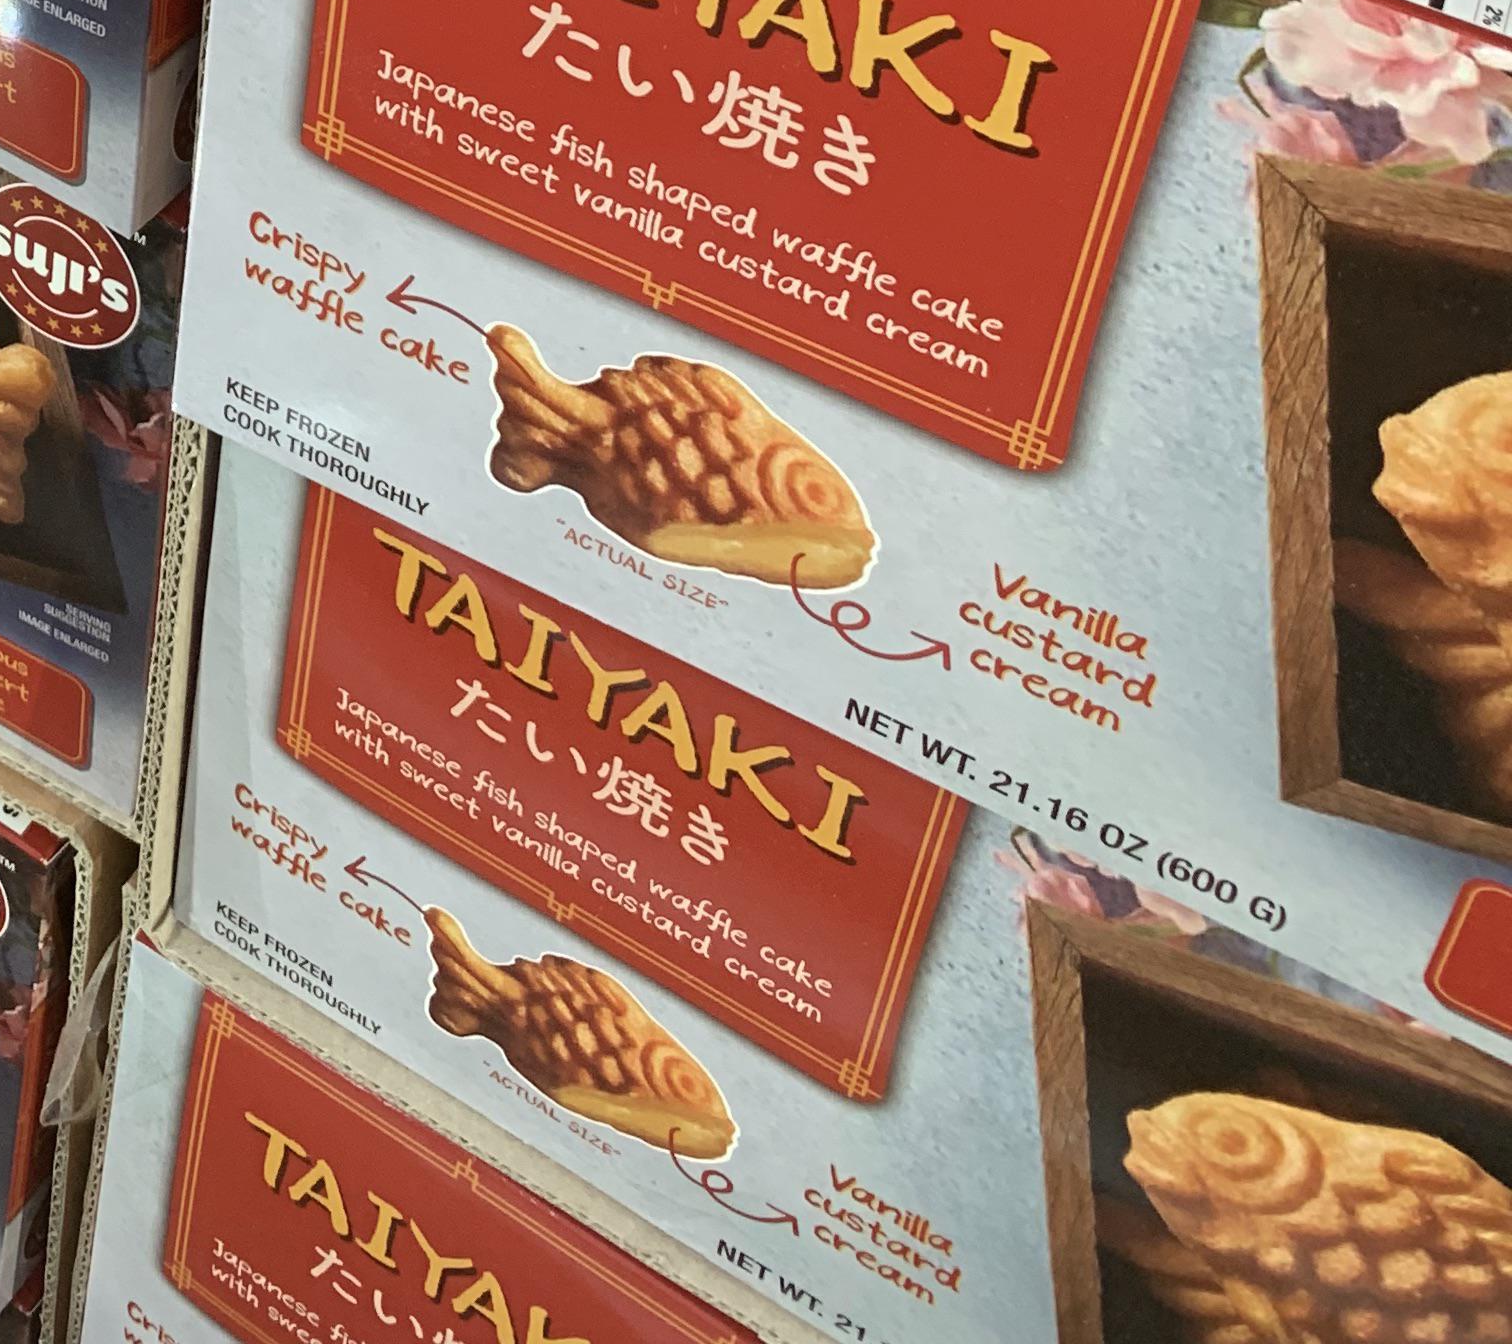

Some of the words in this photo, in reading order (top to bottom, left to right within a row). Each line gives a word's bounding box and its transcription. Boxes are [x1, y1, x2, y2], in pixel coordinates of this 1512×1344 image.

[43, 0, 106, 38] ENLARGED
[518, 1, 878, 198] たい焼き
[250, 211, 367, 297] Crispy
[374, 91, 444, 145] with
[457, 132, 559, 196] sweet
[573, 177, 685, 251] vanilla
[698, 238, 850, 323] custard
[865, 312, 990, 379] cream
[377, 49, 536, 143] Japanese
[550, 125, 614, 178] fish
[628, 162, 758, 244] shaped
[771, 221, 897, 298] waffle
[912, 285, 1005, 342] cake
[244, 253, 368, 330] waffle
[380, 322, 472, 387] cake
[222, 402, 280, 448] COOK
[284, 430, 431, 518] THOROUGHLY
[225, 376, 279, 421] KEEP
[284, 406, 371, 463] FROZEN
[958, 596, 1158, 710] custard
[992, 561, 1148, 661] Vanilla
[374, 527, 868, 864] TAIYAKI
[970, 644, 1123, 734] cream
[234, 782, 329, 861] Crispy
[447, 675, 729, 866] たい焼き
[845, 698, 914, 747] NET
[921, 732, 977, 781] WT.
[989, 769, 1089, 832] 21.16
[1098, 820, 1151, 863] OZ
[1156, 848, 1239, 905] (600
[1248, 894, 1289, 933] G)
[230, 813, 328, 891] waffle
[339, 885, 413, 947] cake
